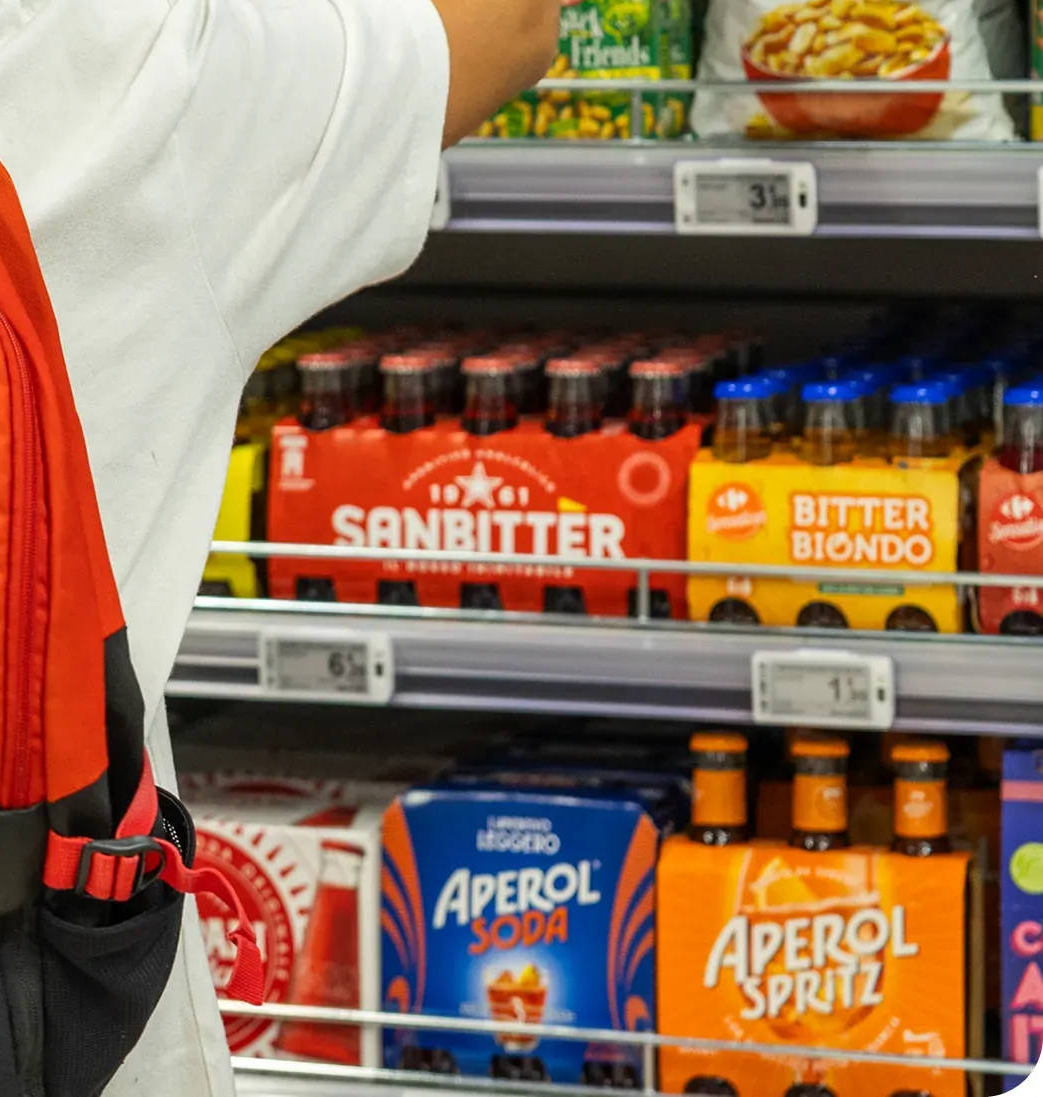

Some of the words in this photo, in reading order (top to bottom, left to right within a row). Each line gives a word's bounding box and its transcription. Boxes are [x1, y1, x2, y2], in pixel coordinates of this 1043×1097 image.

[571, 35, 651, 67] Friends
[331, 504, 626, 560] SANBITTER
[791, 494, 930, 531] BITTER
[790, 530, 933, 565] BIONDO
[433, 860, 602, 929] APEROL
[468, 906, 569, 954] SODA
[703, 905, 920, 989] APEROL
[740, 961, 884, 1019] SPRITZ
